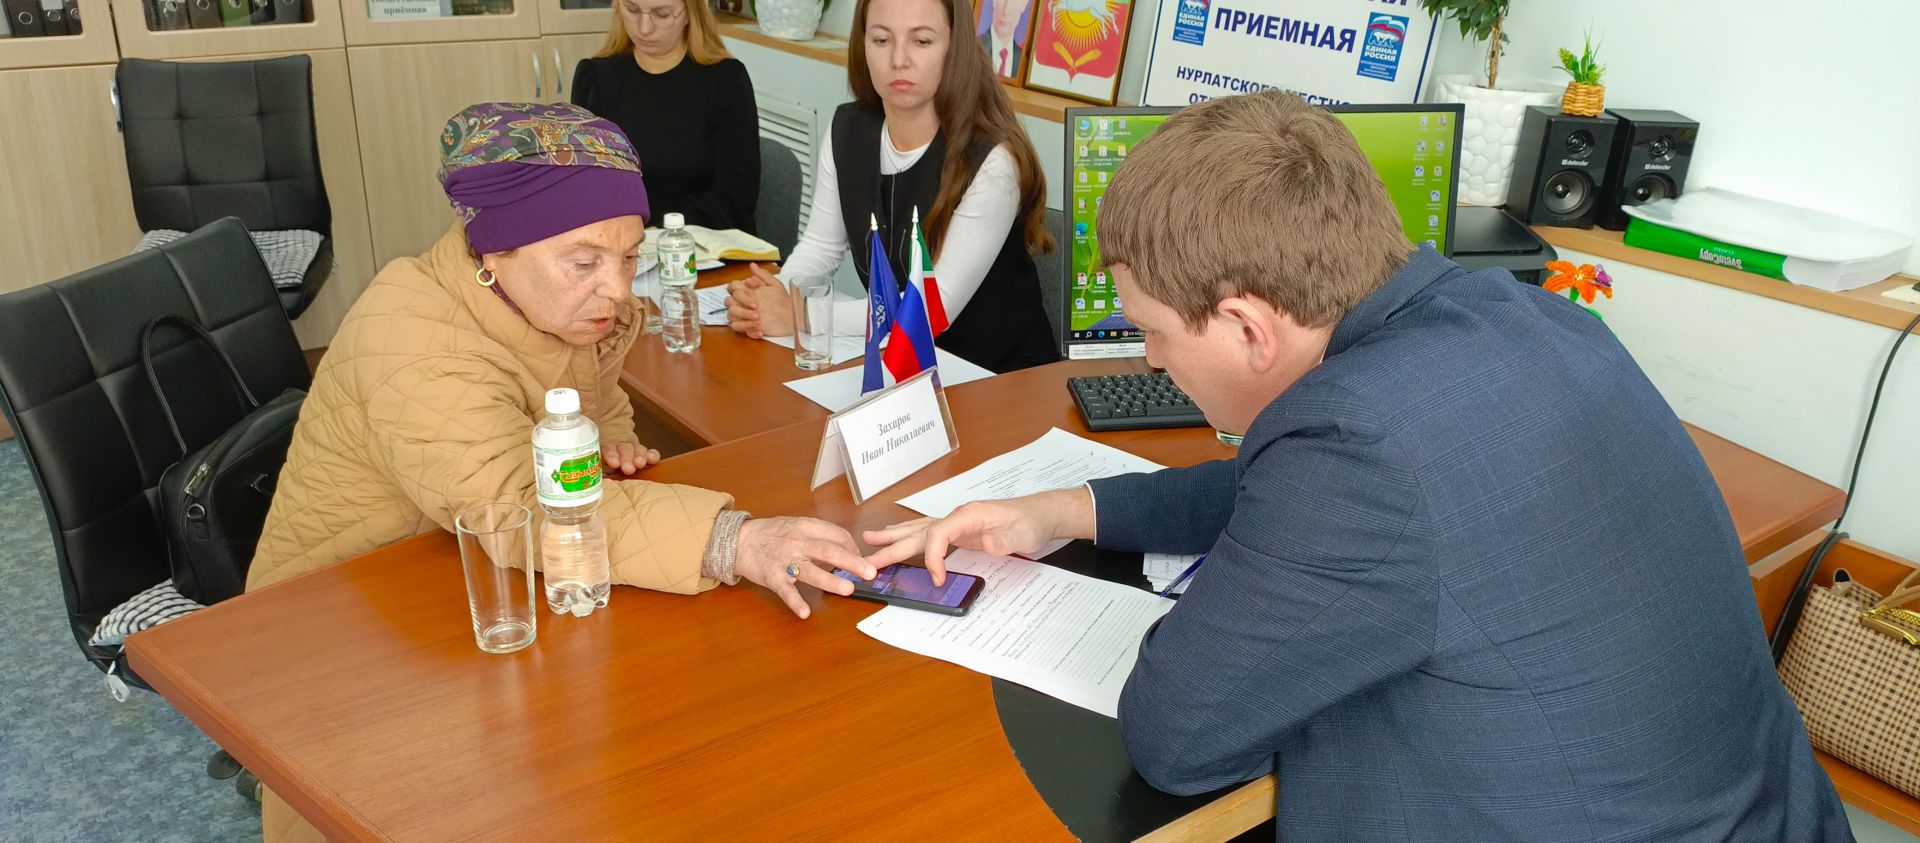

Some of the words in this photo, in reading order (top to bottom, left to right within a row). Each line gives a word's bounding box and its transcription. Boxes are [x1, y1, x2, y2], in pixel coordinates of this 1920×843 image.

[1214, 7, 1357, 53] ПРИЕМНАЯ
[1364, 51, 1396, 62] РОССИЯ
[1365, 44, 1398, 55] ЕДИНАЯ
[1699, 248, 1743, 270] SvetoCopy
[876, 411, 912, 437] Захаров
[861, 448, 885, 466] Иван
[885, 418, 936, 453] Николаевич
